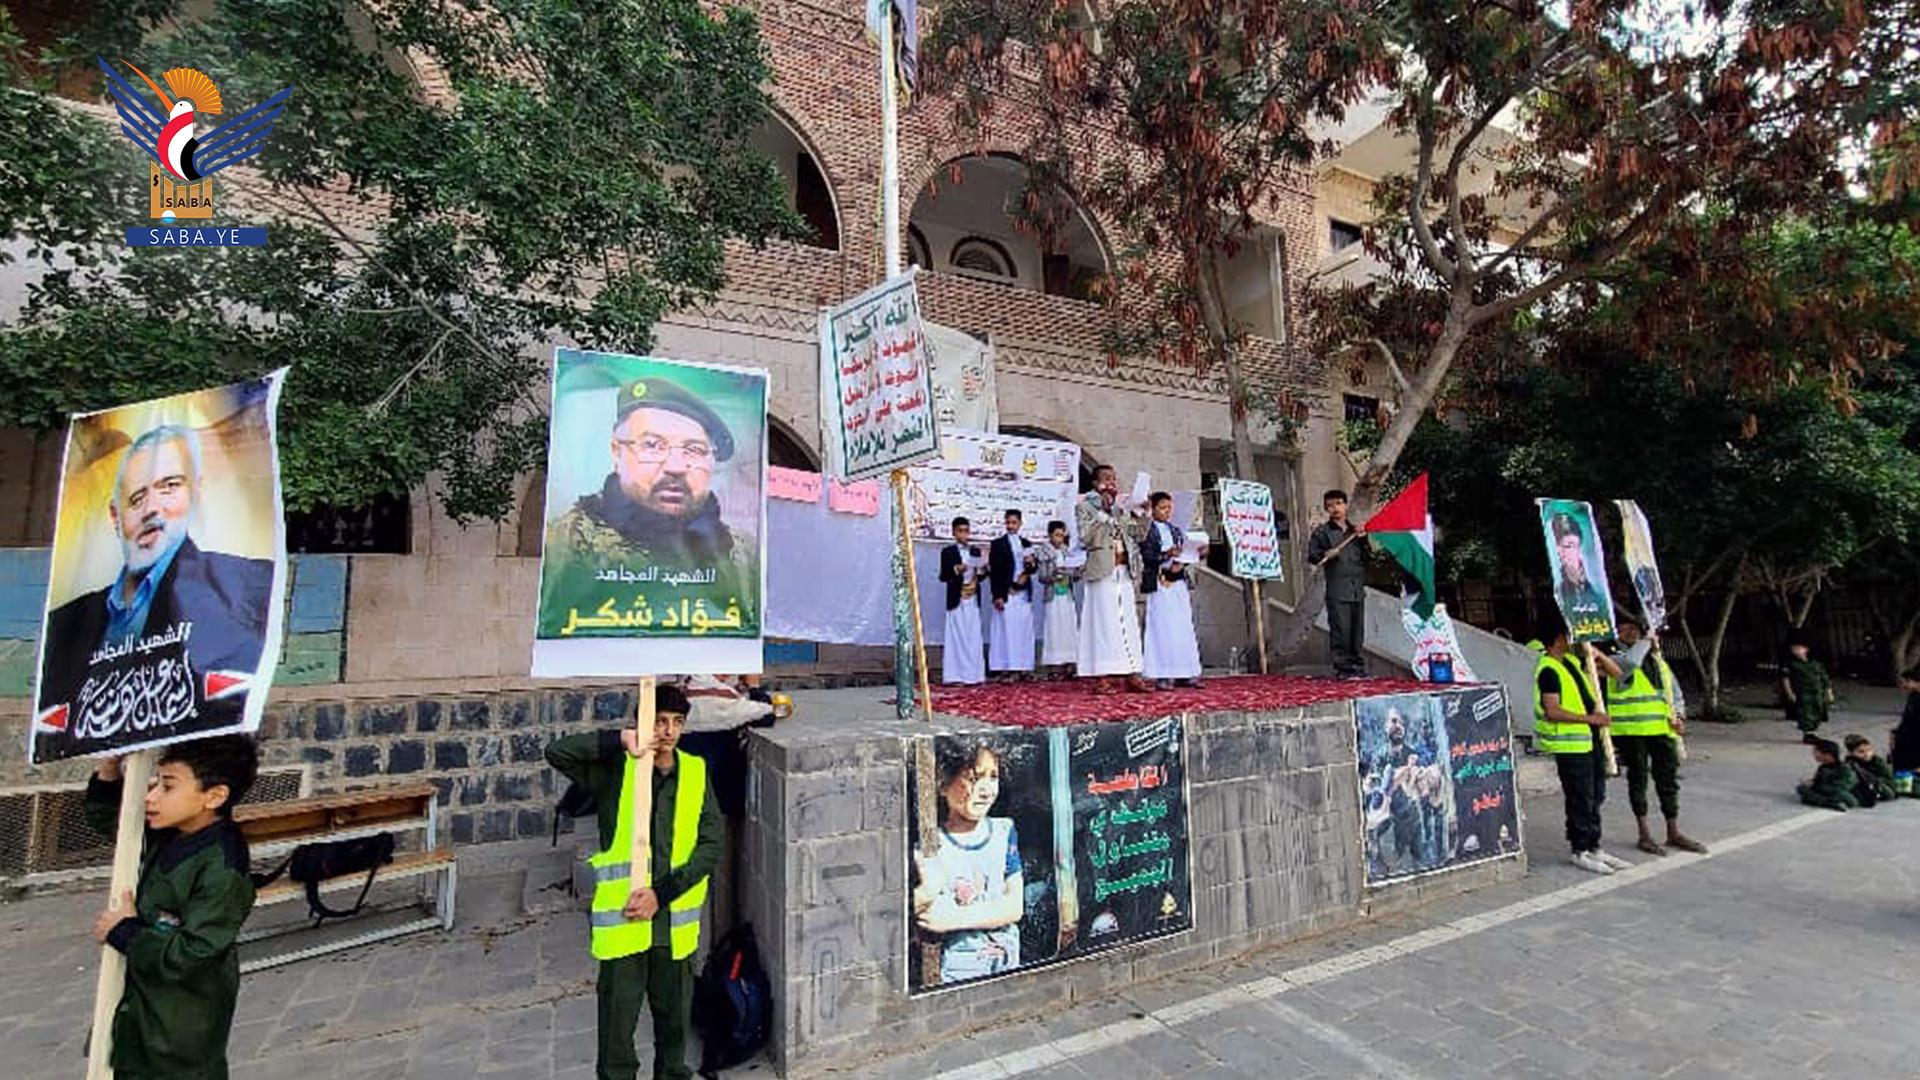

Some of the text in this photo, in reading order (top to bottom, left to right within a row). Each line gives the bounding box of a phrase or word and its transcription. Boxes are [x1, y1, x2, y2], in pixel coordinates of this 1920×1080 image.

[595, 564, 717, 588] الشهيد المجاهد
[561, 594, 743, 636] فؤاد شكر
[89, 622, 193, 666] الشهيد المجاهد
